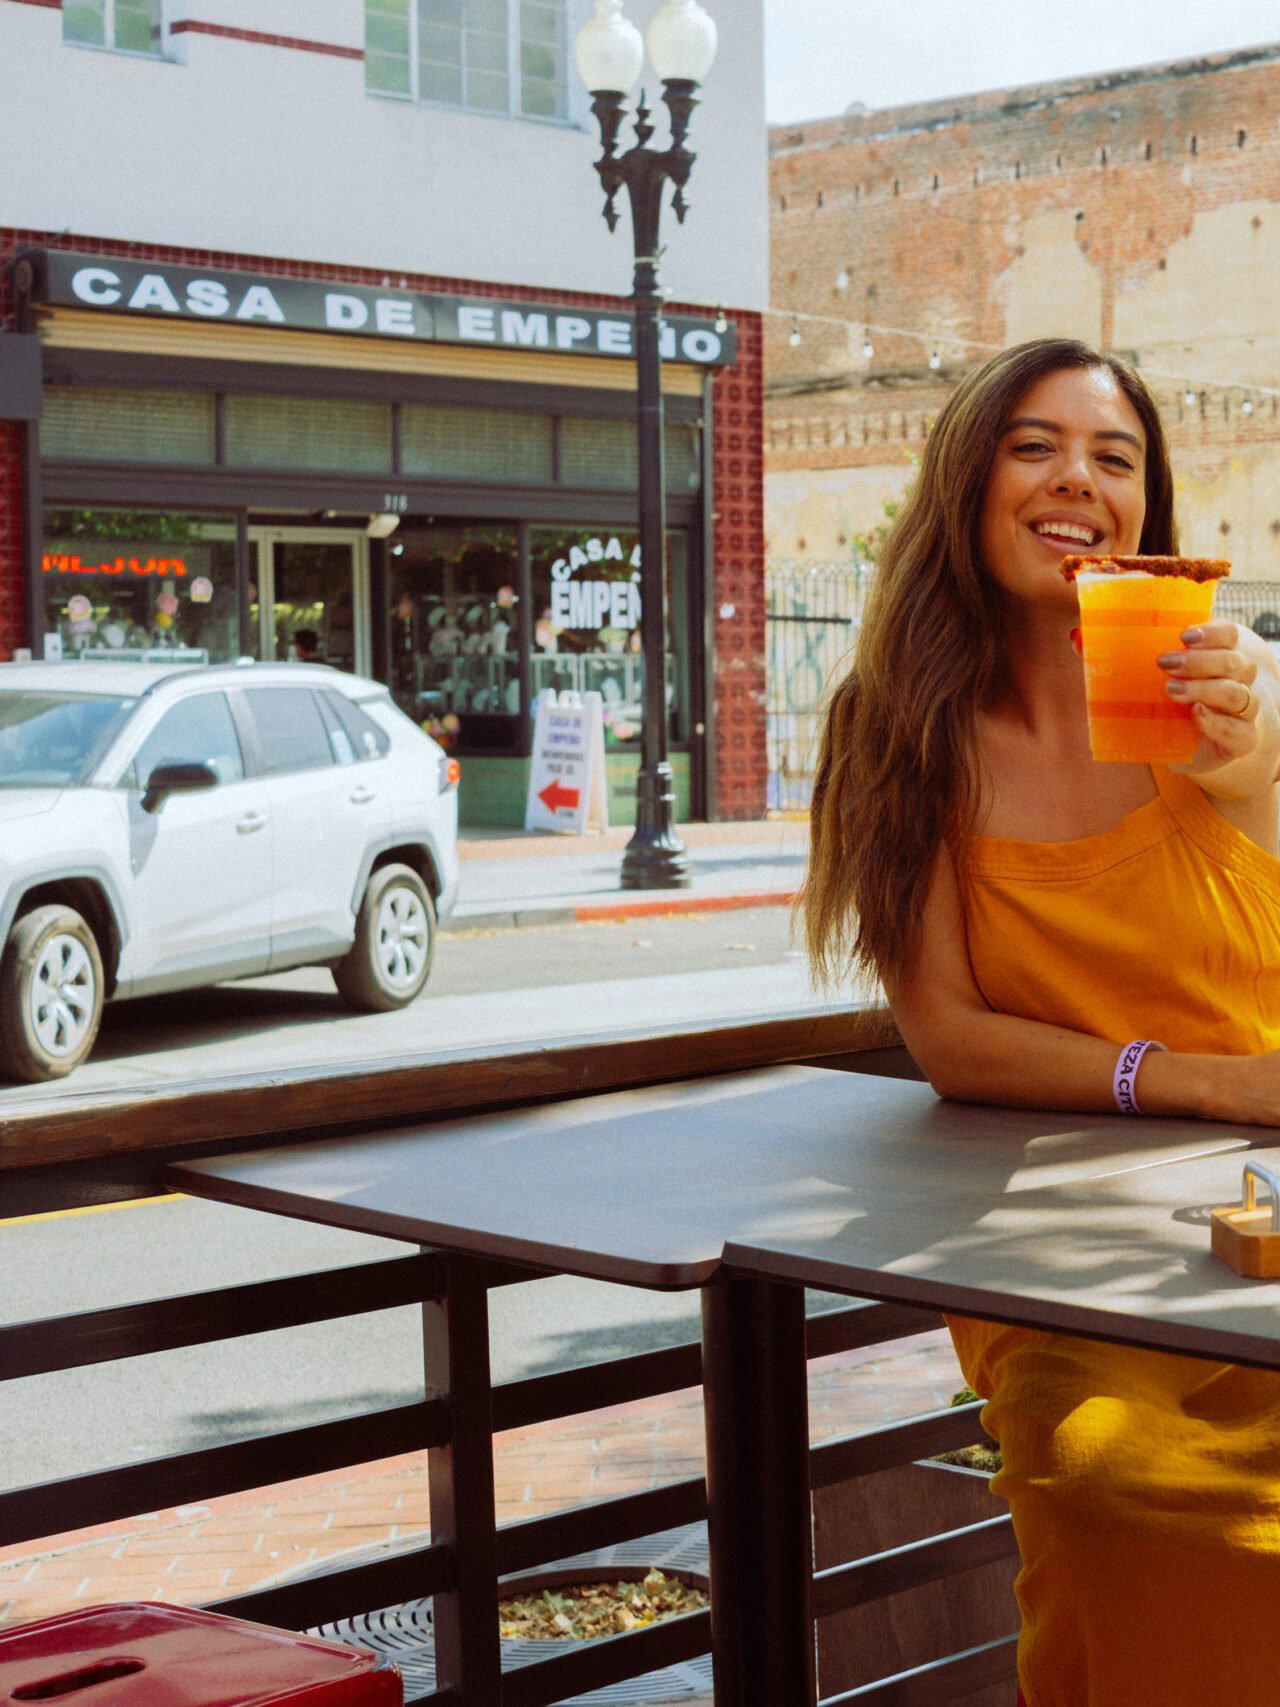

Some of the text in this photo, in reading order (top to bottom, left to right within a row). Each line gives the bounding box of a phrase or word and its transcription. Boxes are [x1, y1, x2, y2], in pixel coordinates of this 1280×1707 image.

[71, 267, 286, 323] CASA
[324, 293, 416, 335] DE
[551, 537, 624, 581] CASA
